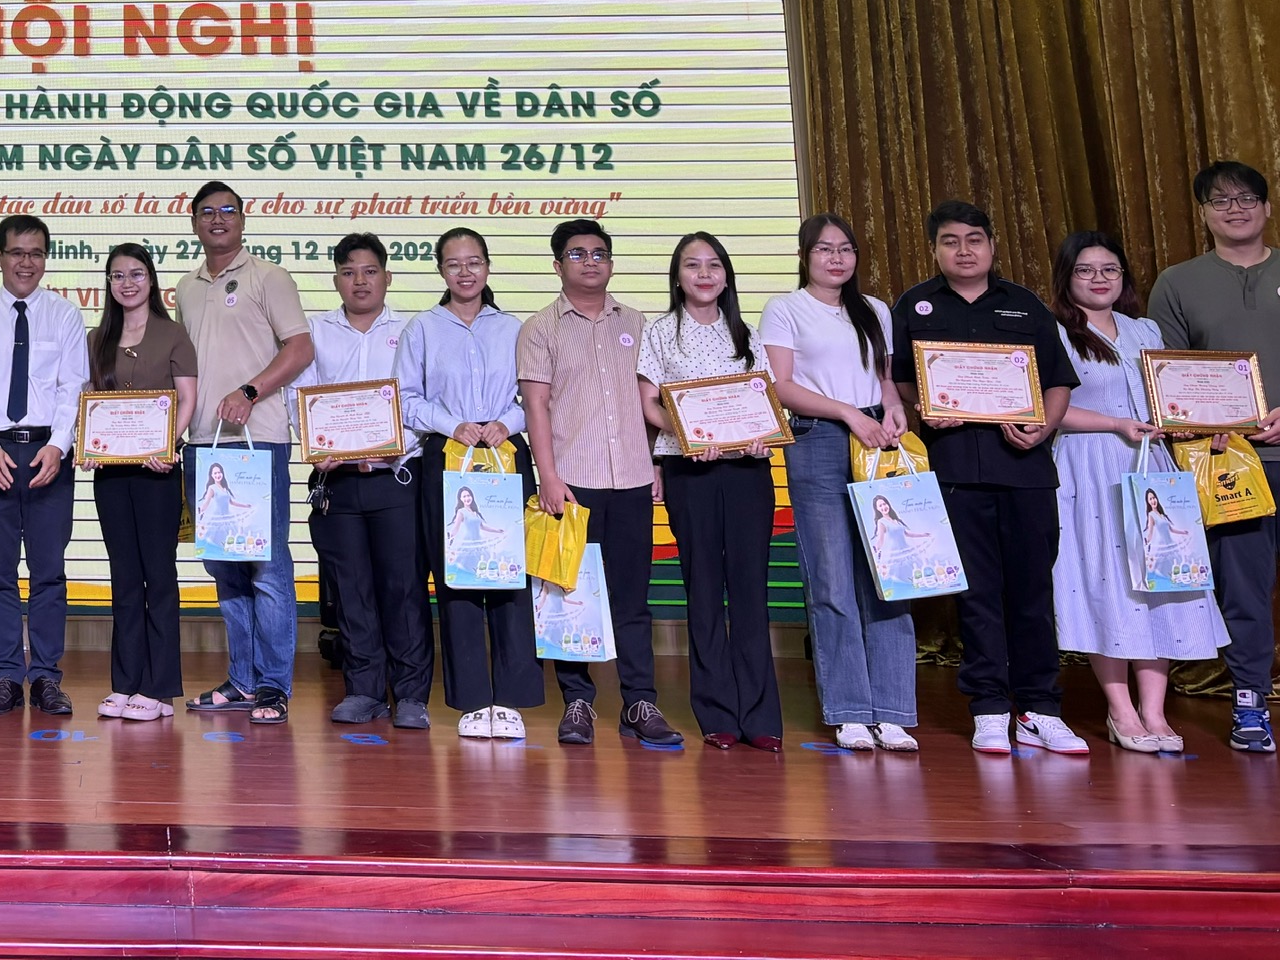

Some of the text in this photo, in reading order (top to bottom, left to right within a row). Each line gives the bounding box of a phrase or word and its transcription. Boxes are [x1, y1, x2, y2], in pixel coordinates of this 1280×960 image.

[123, 2, 315, 73] NGHỊ
[4, 86, 107, 121] HÀNH
[121, 85, 232, 127] ĐỘNG
[246, 79, 359, 119] QUỐC
[374, 90, 443, 119] GIA
[455, 77, 501, 119] VỀ
[516, 83, 595, 119] DÂN
[609, 78, 661, 119] SỐ
[38, 136, 141, 172] NGÀY
[155, 135, 234, 171] DÂN
[247, 131, 297, 171] SỐ
[310, 135, 388, 179] VIỆT
[401, 142, 486, 171] NAM
[500, 142, 614, 174] 26/12
[42, 192, 92, 215] dân
[100, 192, 128, 214] số
[133, 192, 160, 214] là
[261, 192, 308, 215] cho
[314, 197, 344, 219] sự
[350, 193, 413, 220] phát
[420, 192, 481, 215] triển
[487, 192, 533, 215] bền
[176, 241, 203, 260] 27
[291, 241, 319, 260] 12
[390, 241, 438, 260] 202
[1215, 488, 1252, 502] Smart A
